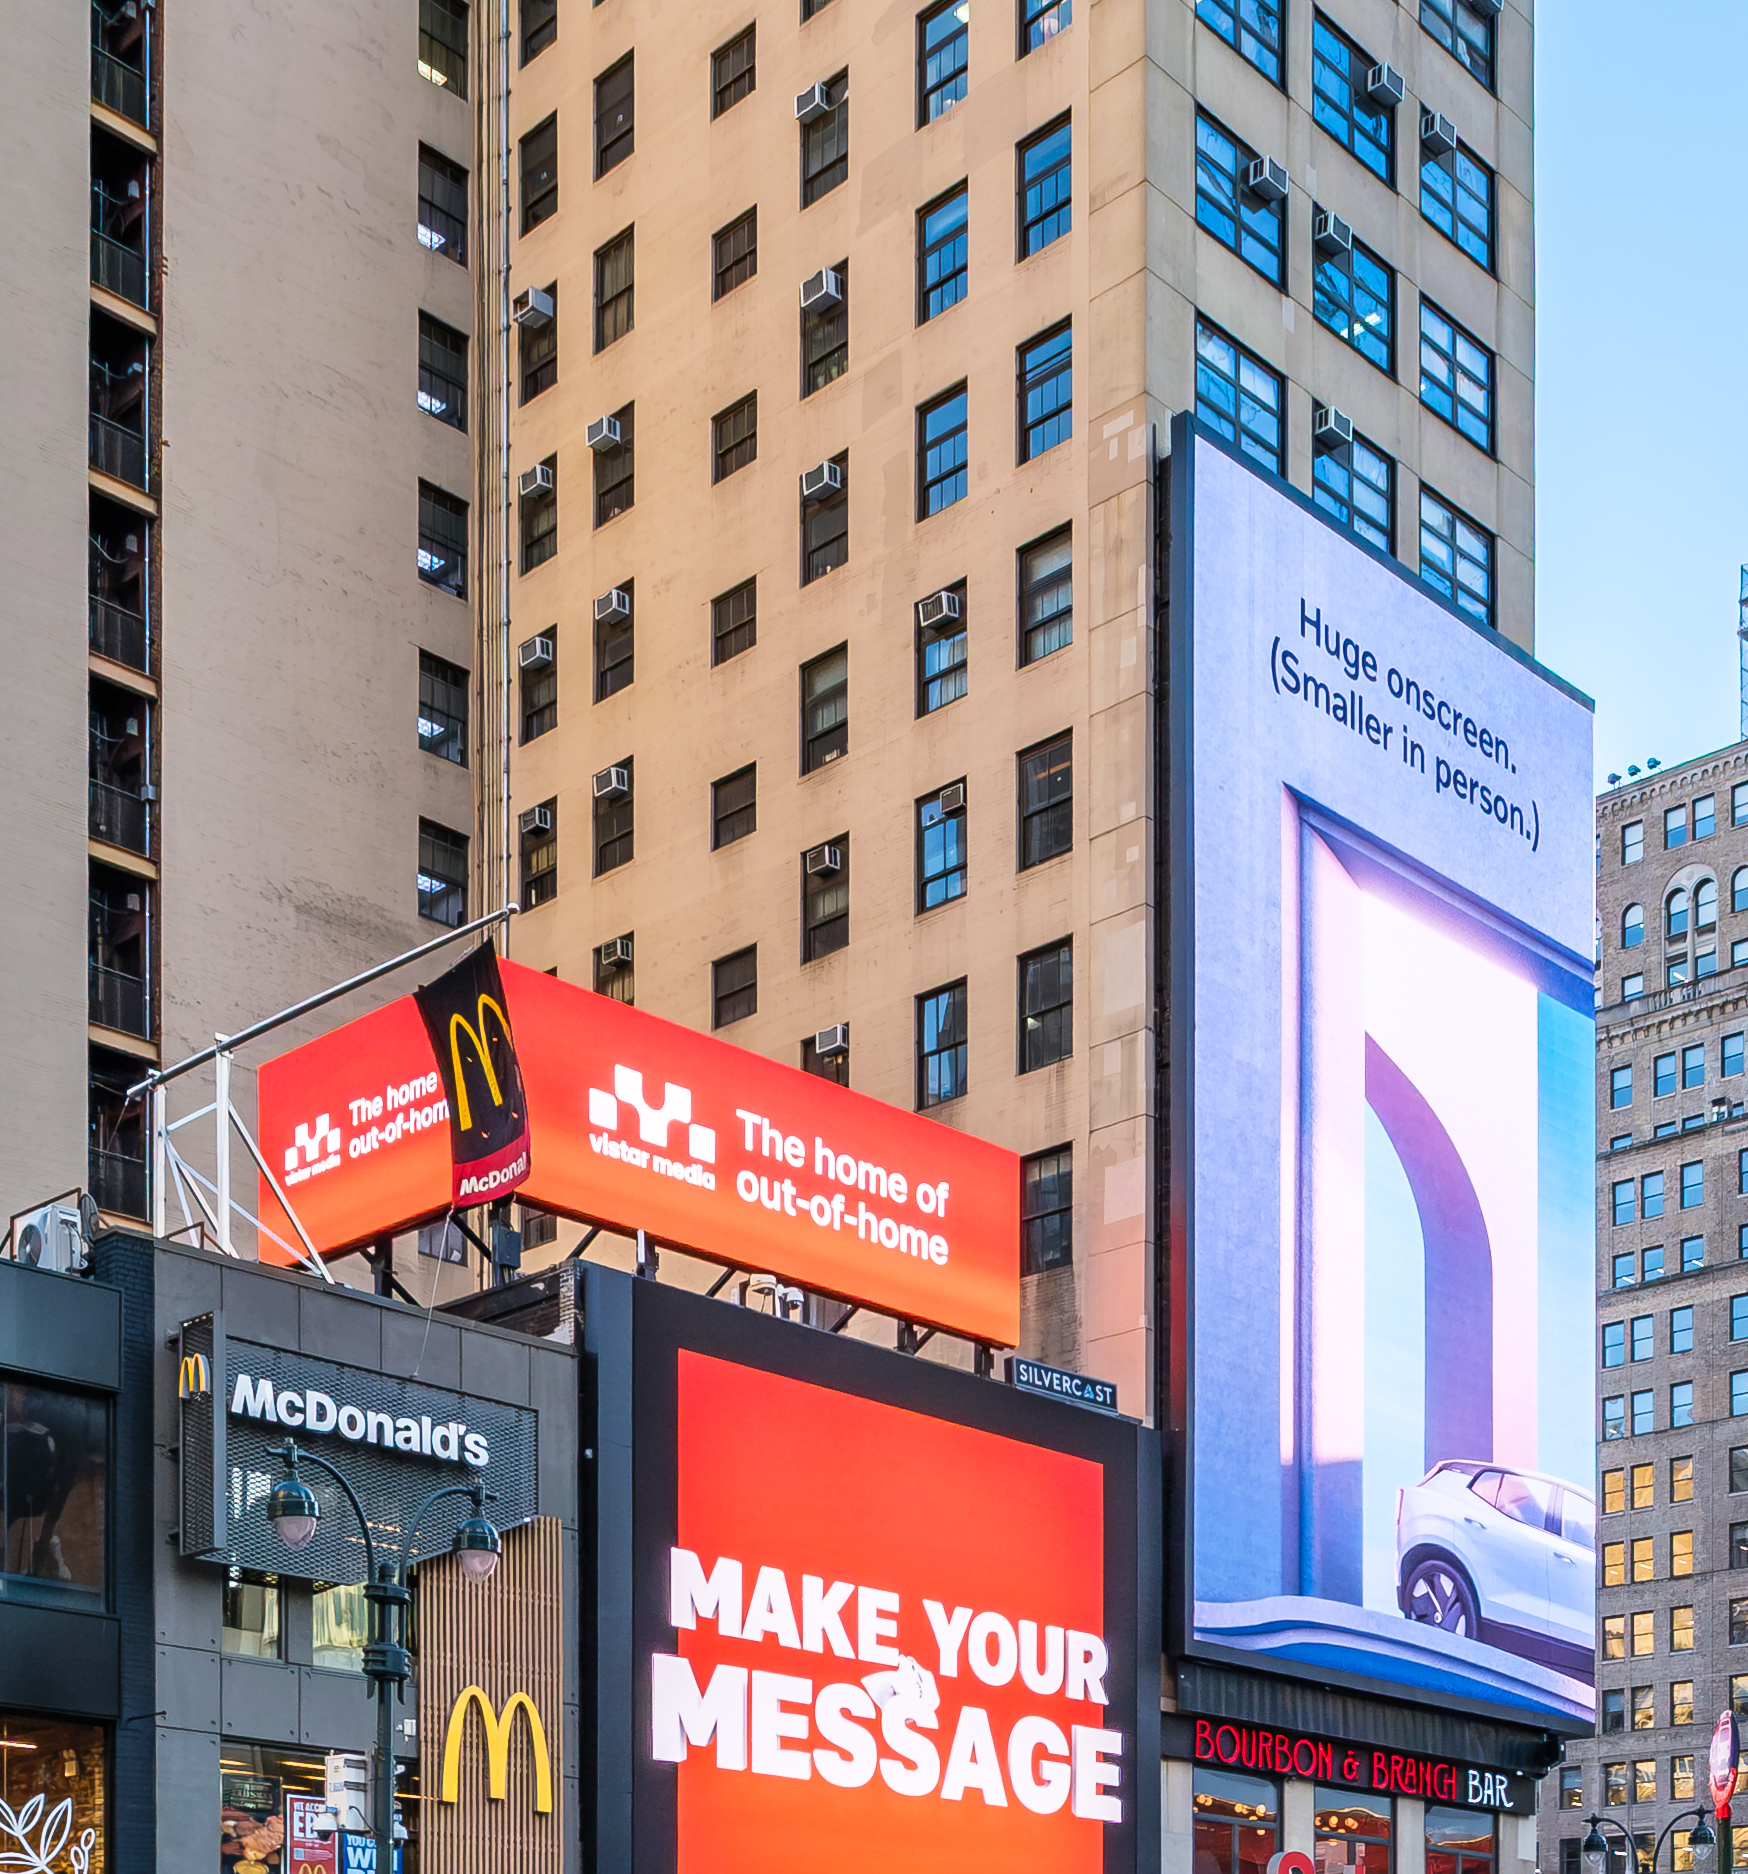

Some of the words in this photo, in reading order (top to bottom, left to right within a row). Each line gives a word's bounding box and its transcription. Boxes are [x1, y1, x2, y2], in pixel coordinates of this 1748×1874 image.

[1300, 597, 1378, 682] Huge
[1387, 666, 1518, 775] onscreen.
[1270, 636, 1394, 751] (Smaller
[1402, 724, 1426, 774] in
[1434, 755, 1541, 852] person.)
[348, 1094, 384, 1126] The
[386, 1071, 438, 1112] home
[348, 1098, 451, 1158] out-of-hom
[459, 1150, 527, 1197] McDonal
[589, 1132, 651, 1171] vistar
[652, 1155, 717, 1192] media
[735, 1107, 807, 1169] The
[814, 1140, 909, 1206] home
[916, 1181, 950, 1218] of
[736, 1172, 949, 1267] out-of-home
[230, 1372, 491, 1468] McDonald's
[669, 1545, 901, 1667] MAKE
[922, 1597, 1111, 1707] YOUR
[651, 1652, 1124, 1825] MESSAGE
[1195, 1719, 1333, 1781] BOURBON
[1372, 1752, 1457, 1800] BRANCH
[1467, 1768, 1515, 1809] BAR
[346, 1834, 365, 1847] YOU
